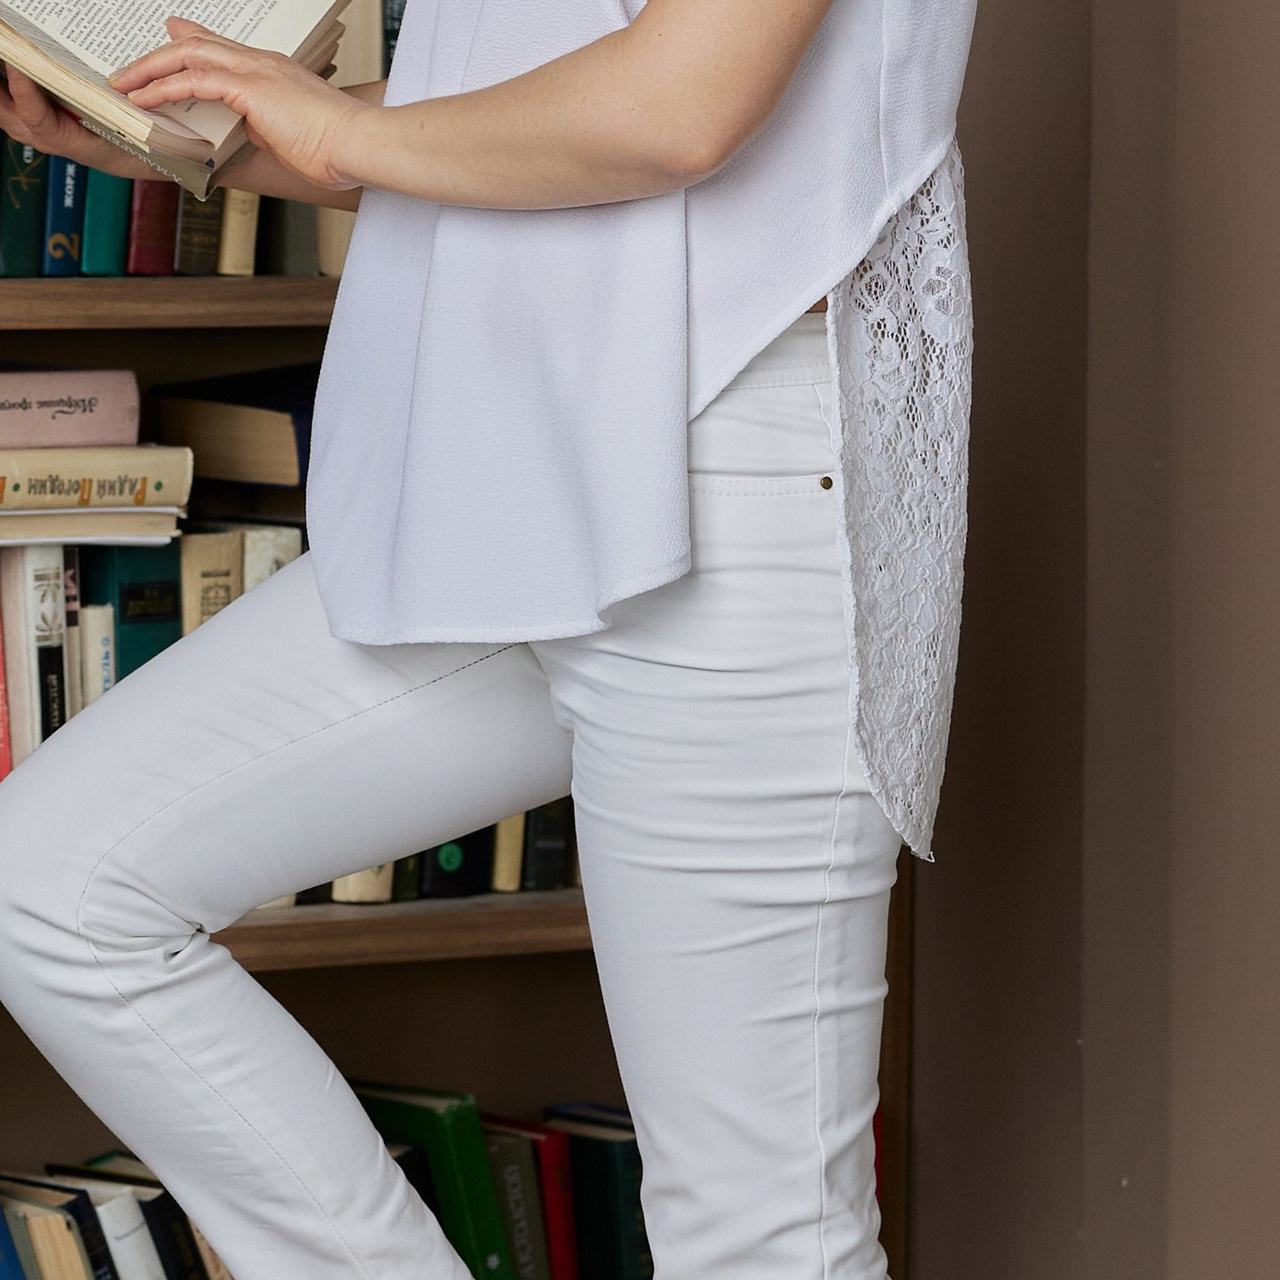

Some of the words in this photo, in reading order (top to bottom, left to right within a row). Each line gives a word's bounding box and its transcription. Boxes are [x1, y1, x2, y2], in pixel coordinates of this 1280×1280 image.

[62, 162, 76, 208] ЖОРЖ
[47, 231, 81, 260] 2
[26, 474, 94, 506] Погодин
[95, 475, 148, 506] Радий
